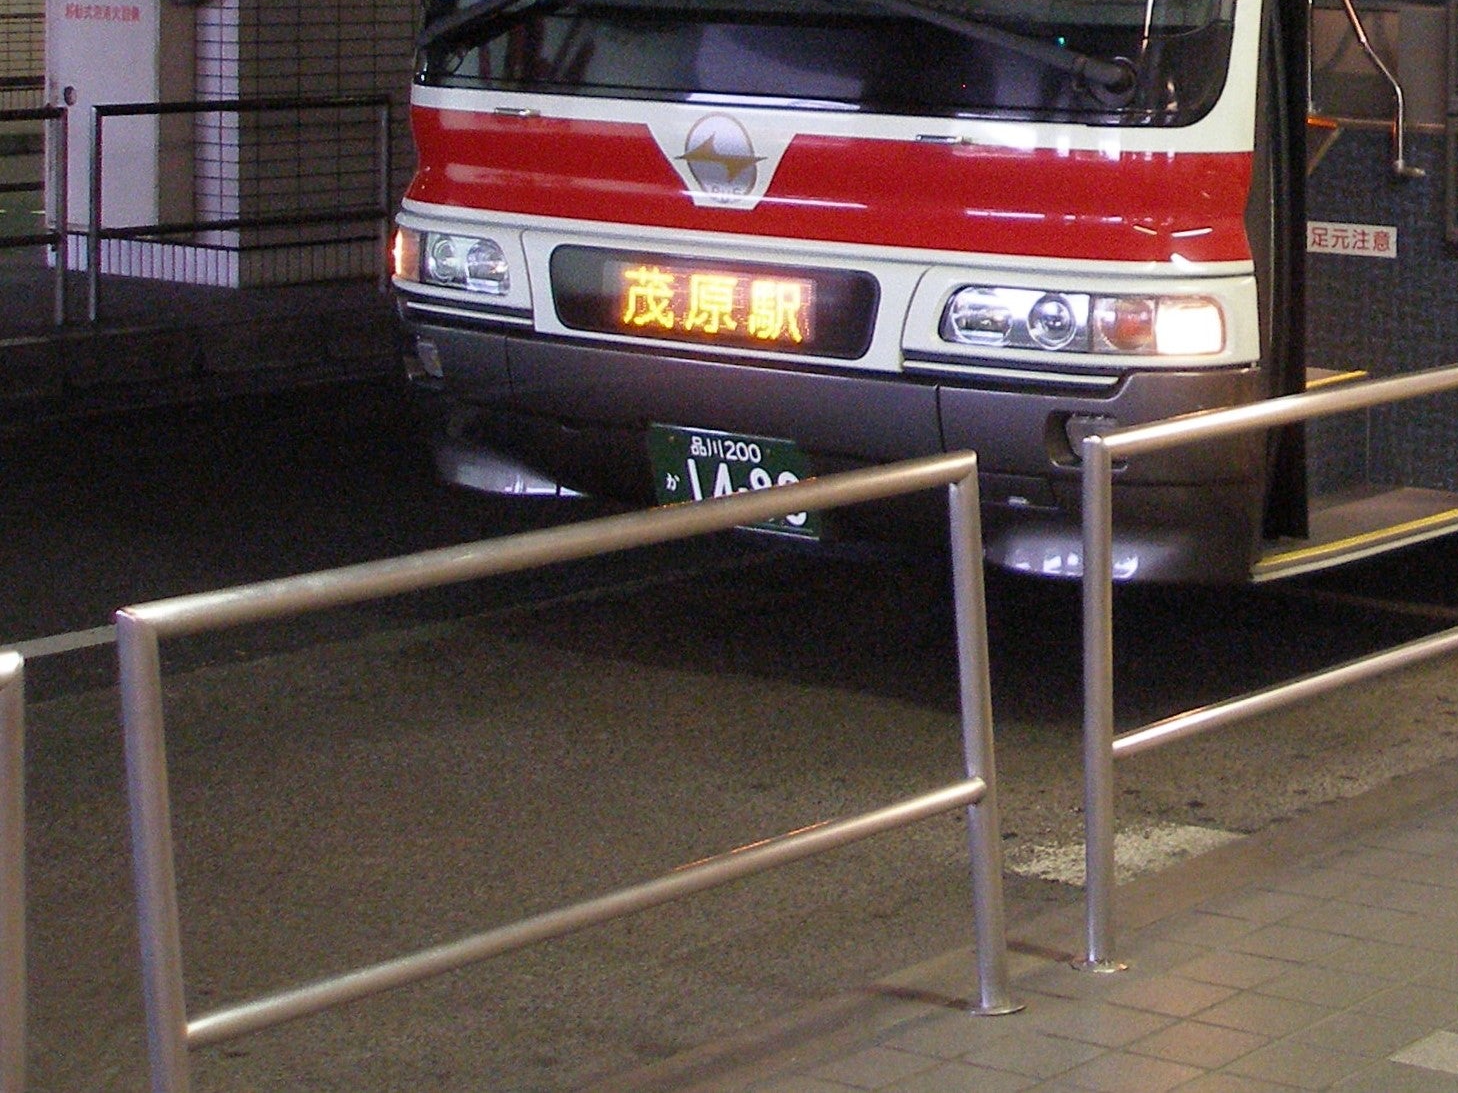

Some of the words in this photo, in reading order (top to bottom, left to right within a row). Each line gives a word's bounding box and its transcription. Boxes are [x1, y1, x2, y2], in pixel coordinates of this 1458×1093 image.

[1311, 226, 1391, 252] 足元注意
[623, 265, 803, 344] 茂原駅
